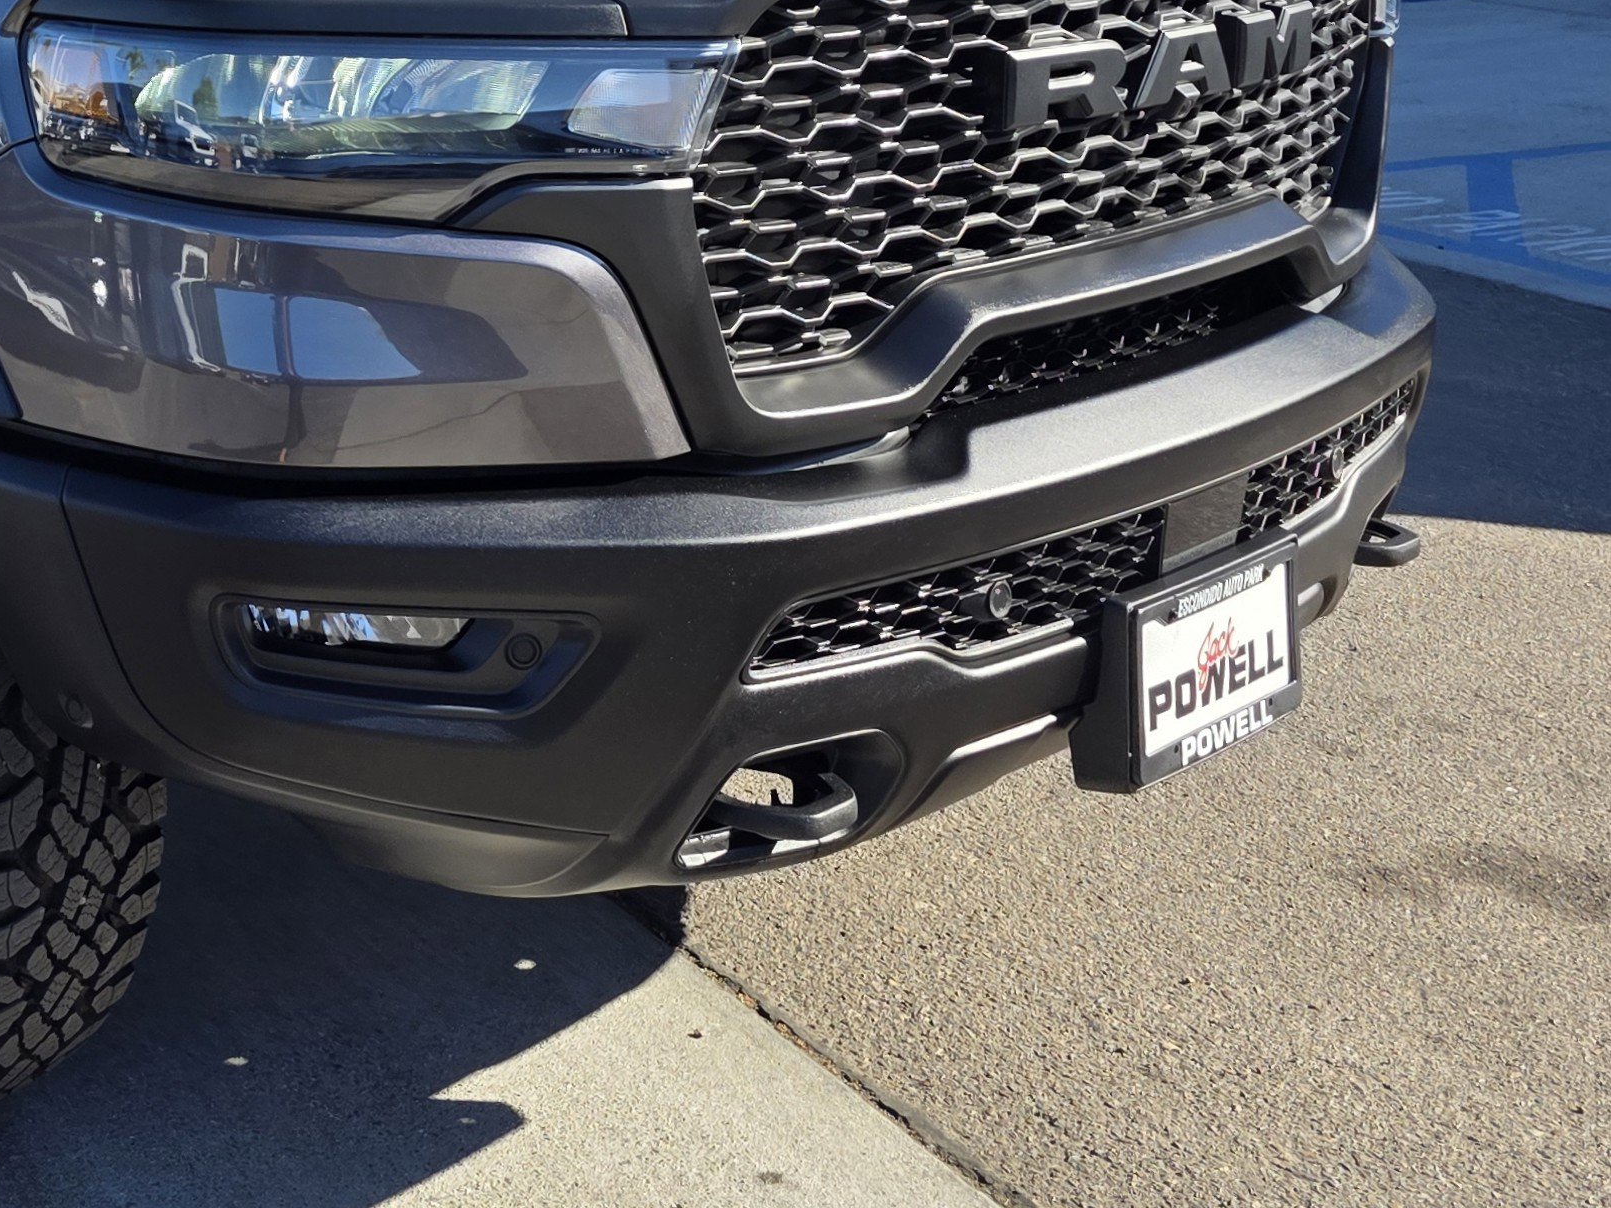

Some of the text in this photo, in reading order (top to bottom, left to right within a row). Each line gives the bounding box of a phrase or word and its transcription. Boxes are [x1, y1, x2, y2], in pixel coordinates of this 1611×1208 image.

[1001, 0, 1314, 132] RAM
[1177, 563, 1265, 619] ESCONDIDO AUTO PARK
[1148, 629, 1284, 732] POWELL
[1181, 699, 1273, 766] POWELL
